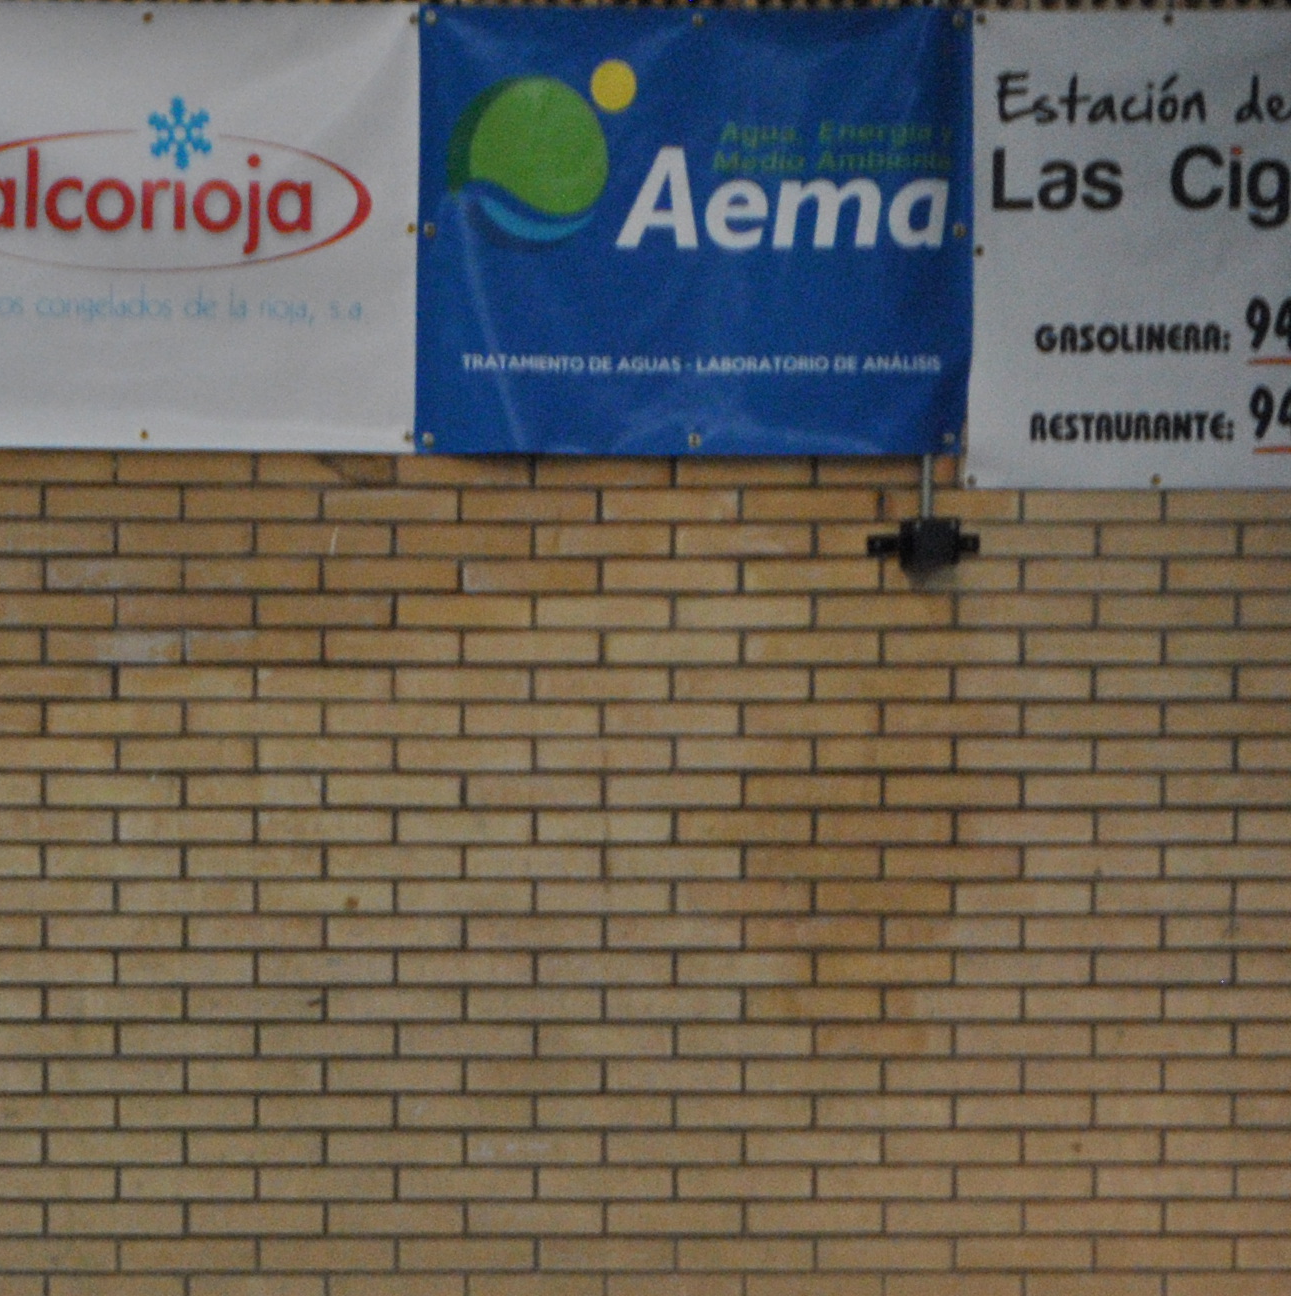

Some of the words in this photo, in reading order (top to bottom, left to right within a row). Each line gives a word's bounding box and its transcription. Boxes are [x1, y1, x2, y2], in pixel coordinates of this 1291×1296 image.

[996, 71, 1207, 125] Estación
[1235, 74, 1291, 123] de
[712, 151, 806, 173] Medio
[816, 151, 953, 173] Ambiente
[616, 146, 949, 251] Aema
[993, 147, 1124, 211] Las
[1171, 144, 1291, 229] Cig
[35, 283, 172, 322] congelados
[183, 285, 216, 319] de
[229, 284, 249, 319] la
[1035, 323, 1231, 354] GASOLINERA:
[462, 353, 585, 373] TRATAMIENTO
[589, 355, 613, 373] DE
[617, 355, 682, 374] AGUAS
[696, 354, 830, 374] LABORATORIO
[833, 355, 858, 374] DE
[863, 351, 942, 374] ANÁLISIS
[1031, 411, 1234, 443] RESTAURANTE:
